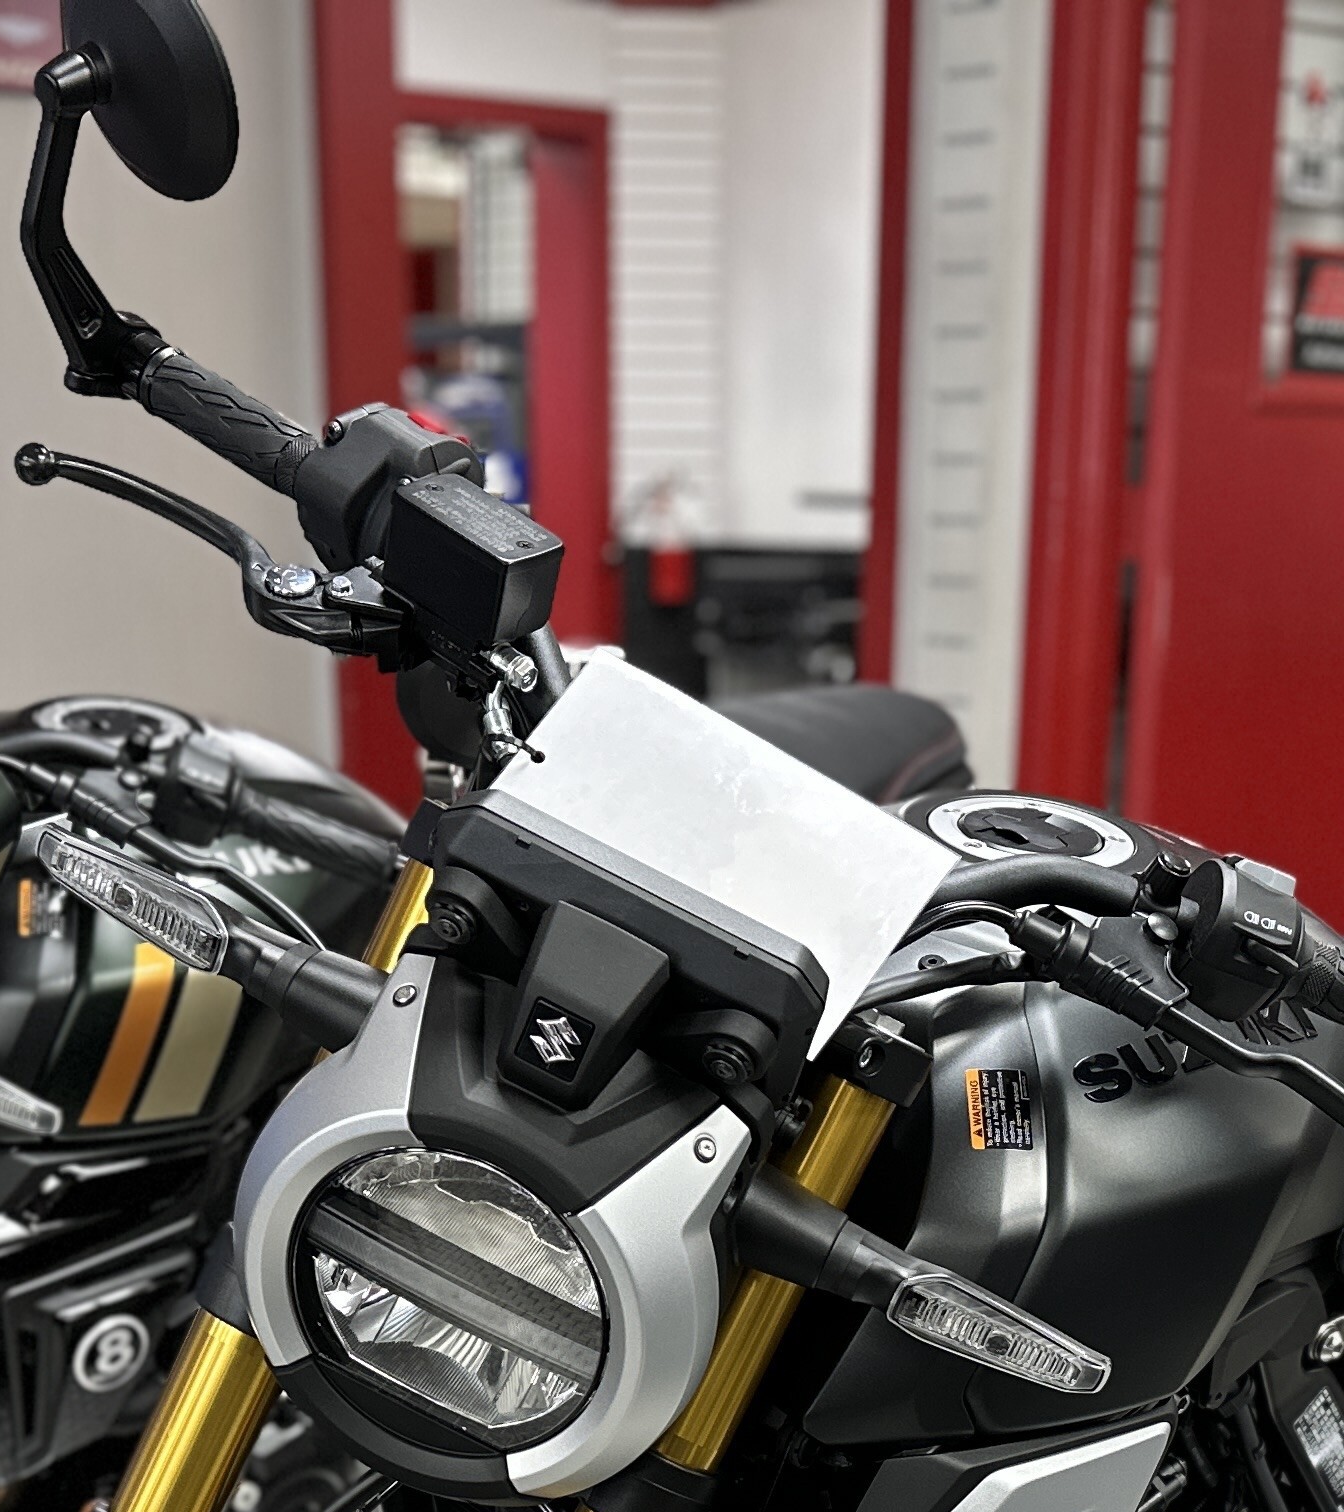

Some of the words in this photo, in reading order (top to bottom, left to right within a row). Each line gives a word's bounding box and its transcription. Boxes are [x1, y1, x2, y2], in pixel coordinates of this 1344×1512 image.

[1073, 1000, 1318, 1103] SUKI
[970, 1080, 982, 1127] WARNING
[96, 1328, 135, 1375] 8
